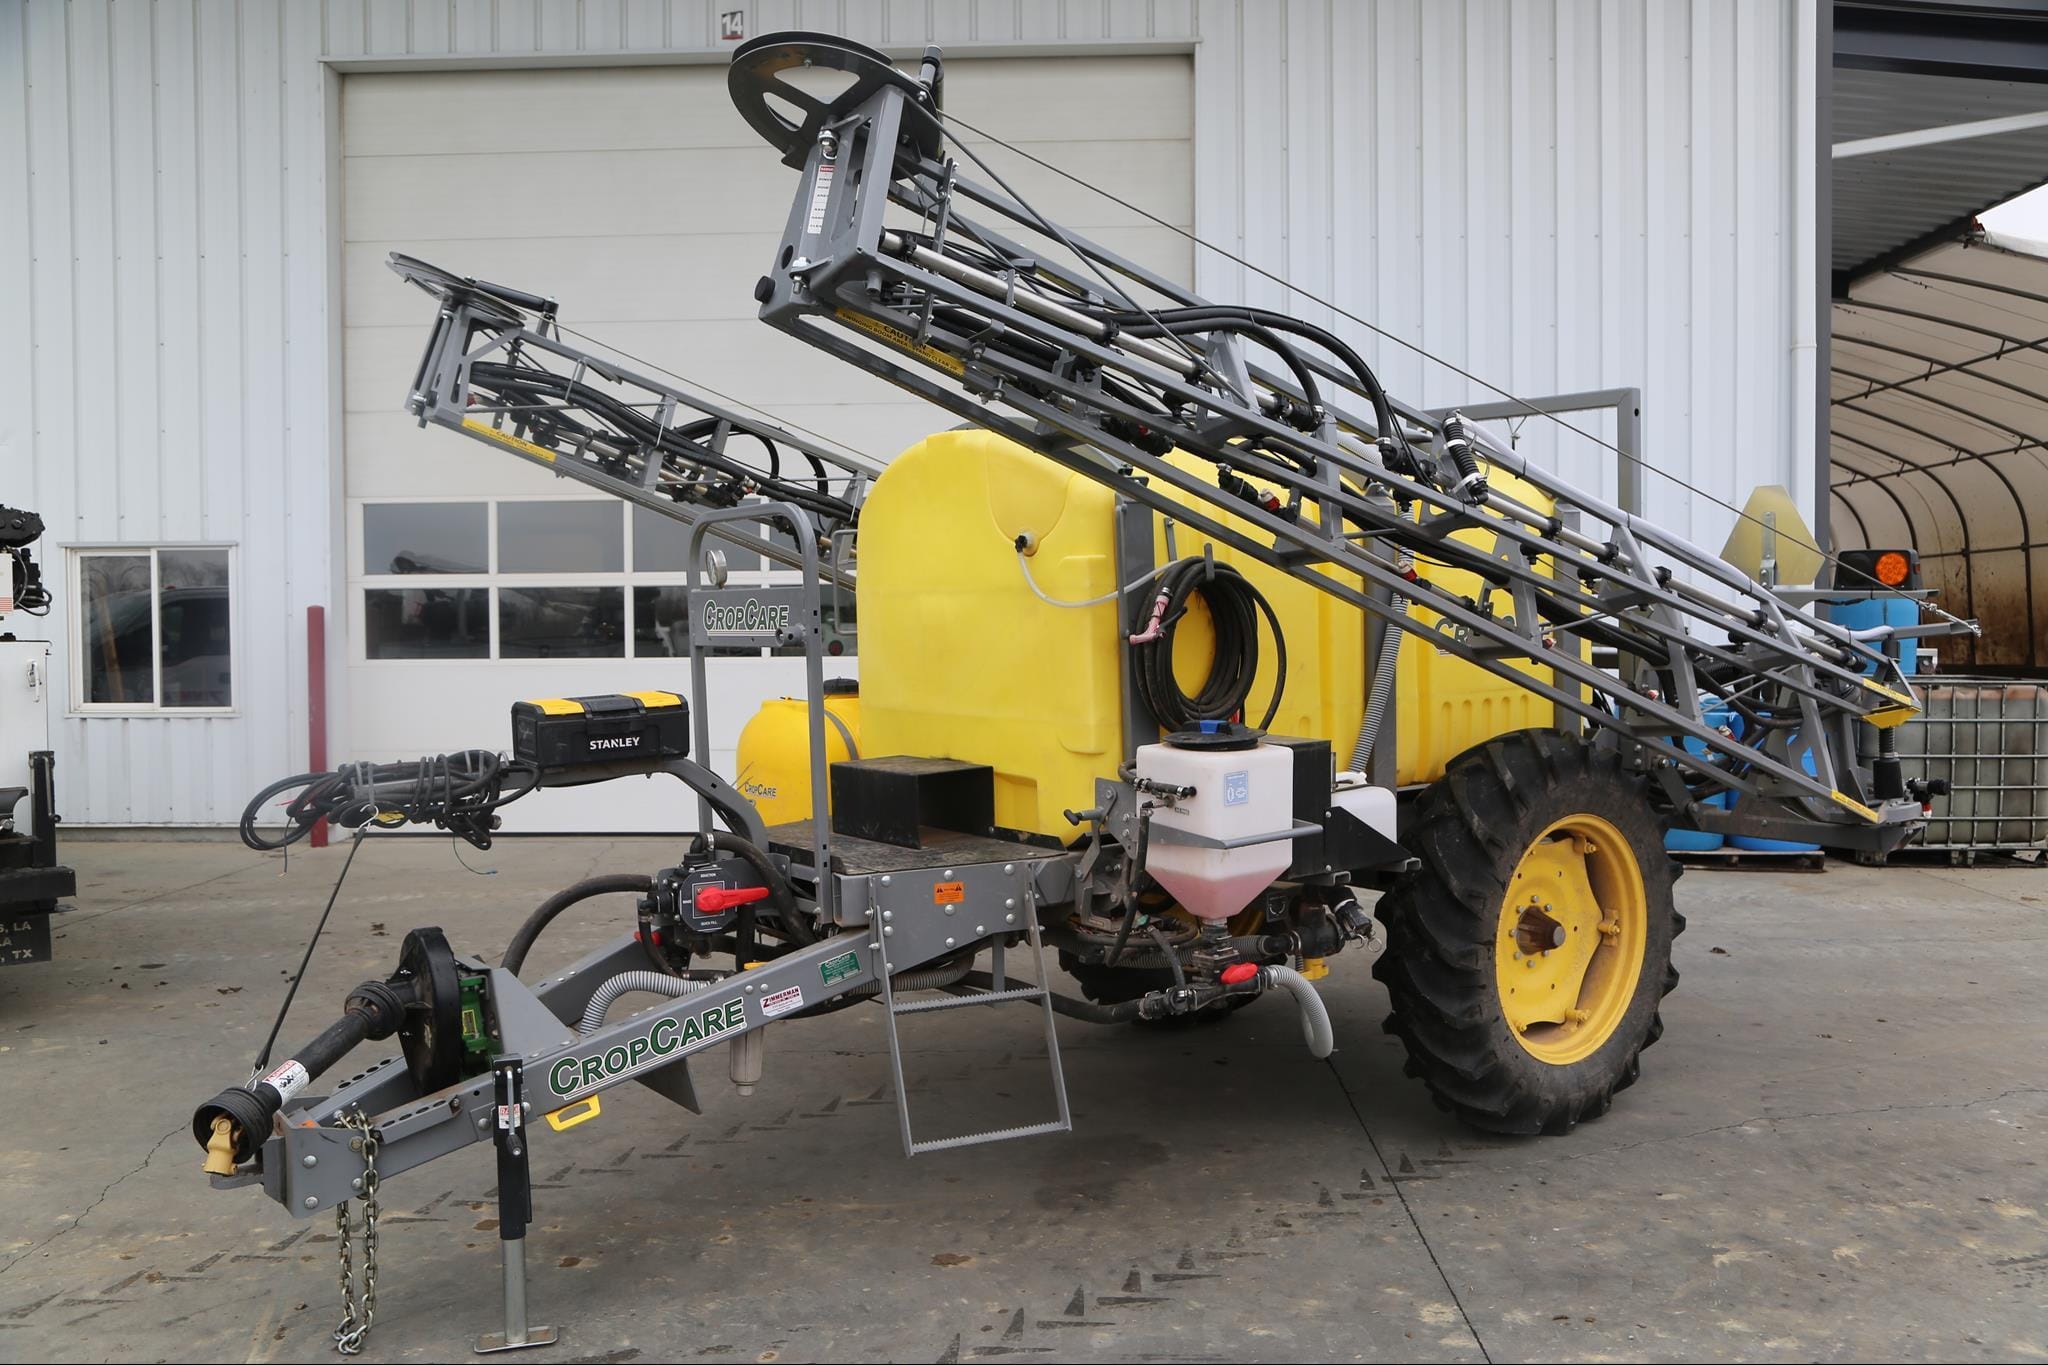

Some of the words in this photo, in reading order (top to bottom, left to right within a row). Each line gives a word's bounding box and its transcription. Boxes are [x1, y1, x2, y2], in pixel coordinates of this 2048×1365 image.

[722, 12, 742, 36] 14
[884, 326, 926, 350] CAUTN
[590, 736, 640, 750] STANLEY
[14, 921, 32, 931] LA
[12, 949, 33, 959] TX
[762, 988, 799, 1008] ZIMMERMAN
[549, 997, 746, 1095] CROPCARE
